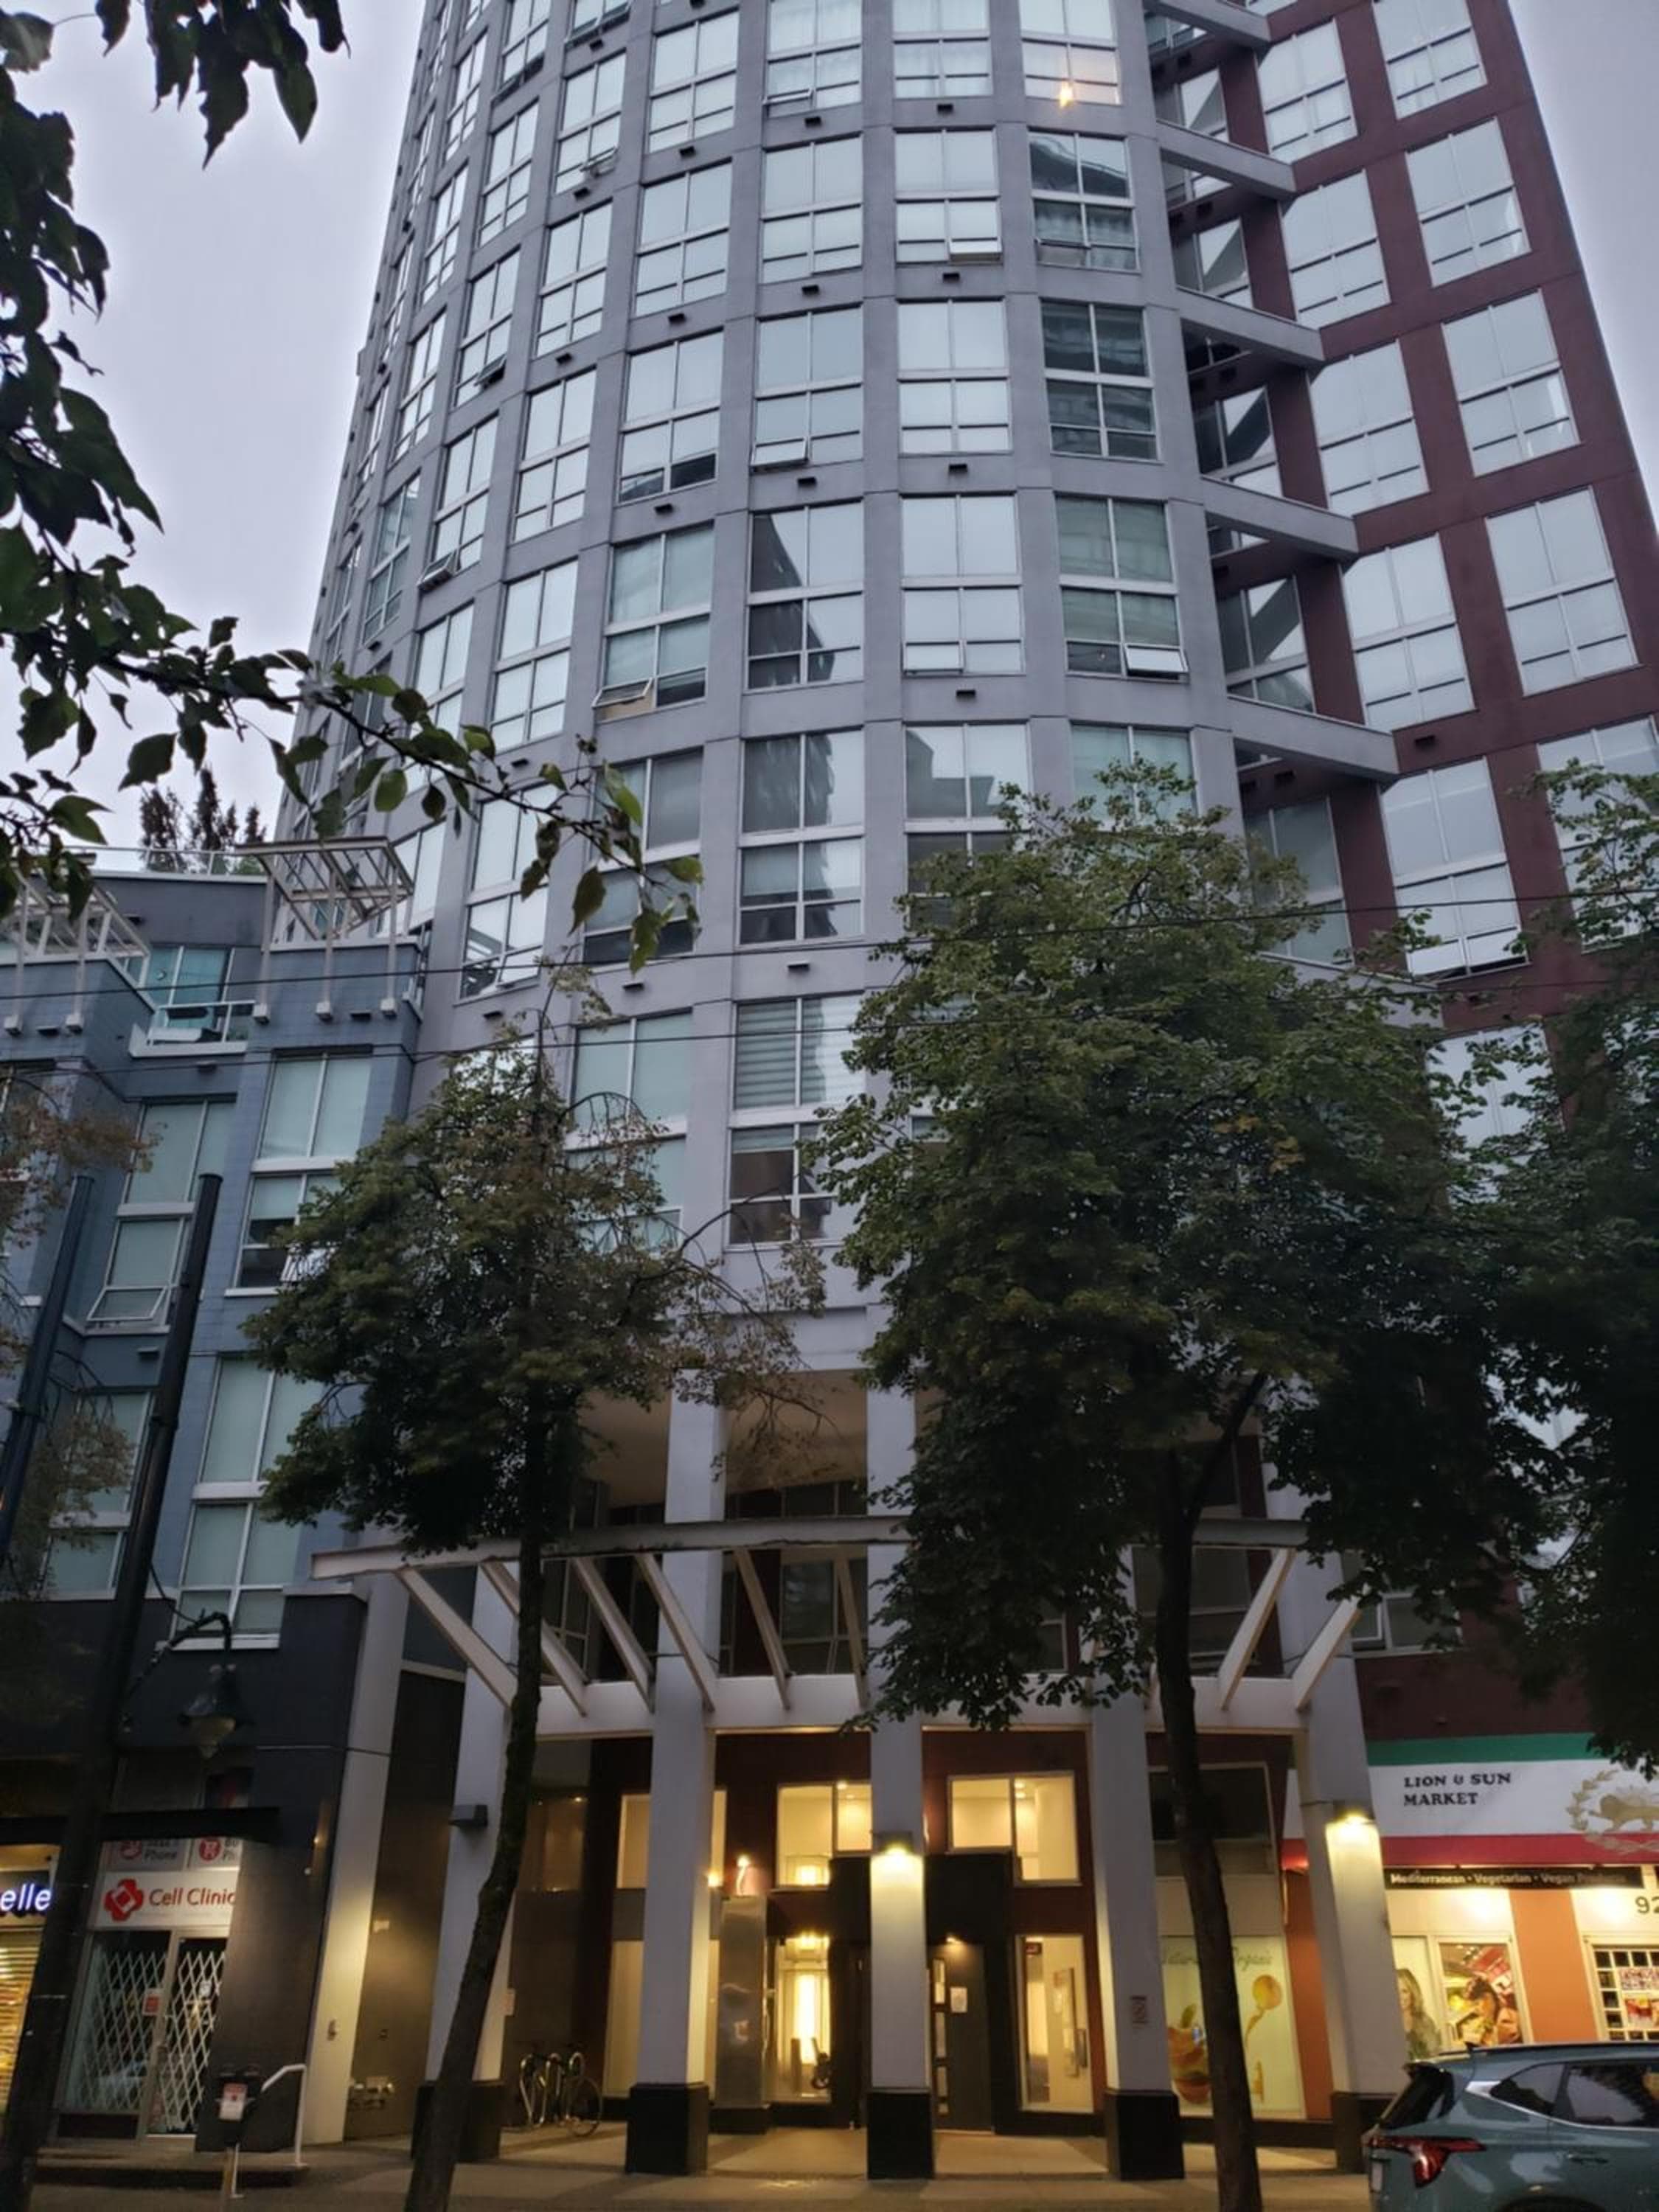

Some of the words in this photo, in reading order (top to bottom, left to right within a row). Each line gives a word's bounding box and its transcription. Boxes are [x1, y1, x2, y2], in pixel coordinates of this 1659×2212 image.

[1404, 1775, 1447, 1787] LION
[1470, 1773, 1511, 1785] SUN
[1404, 1792, 1478, 1806] MARKET
[149, 1887, 183, 1906] Cell
[187, 1887, 237, 1906] Clinic
